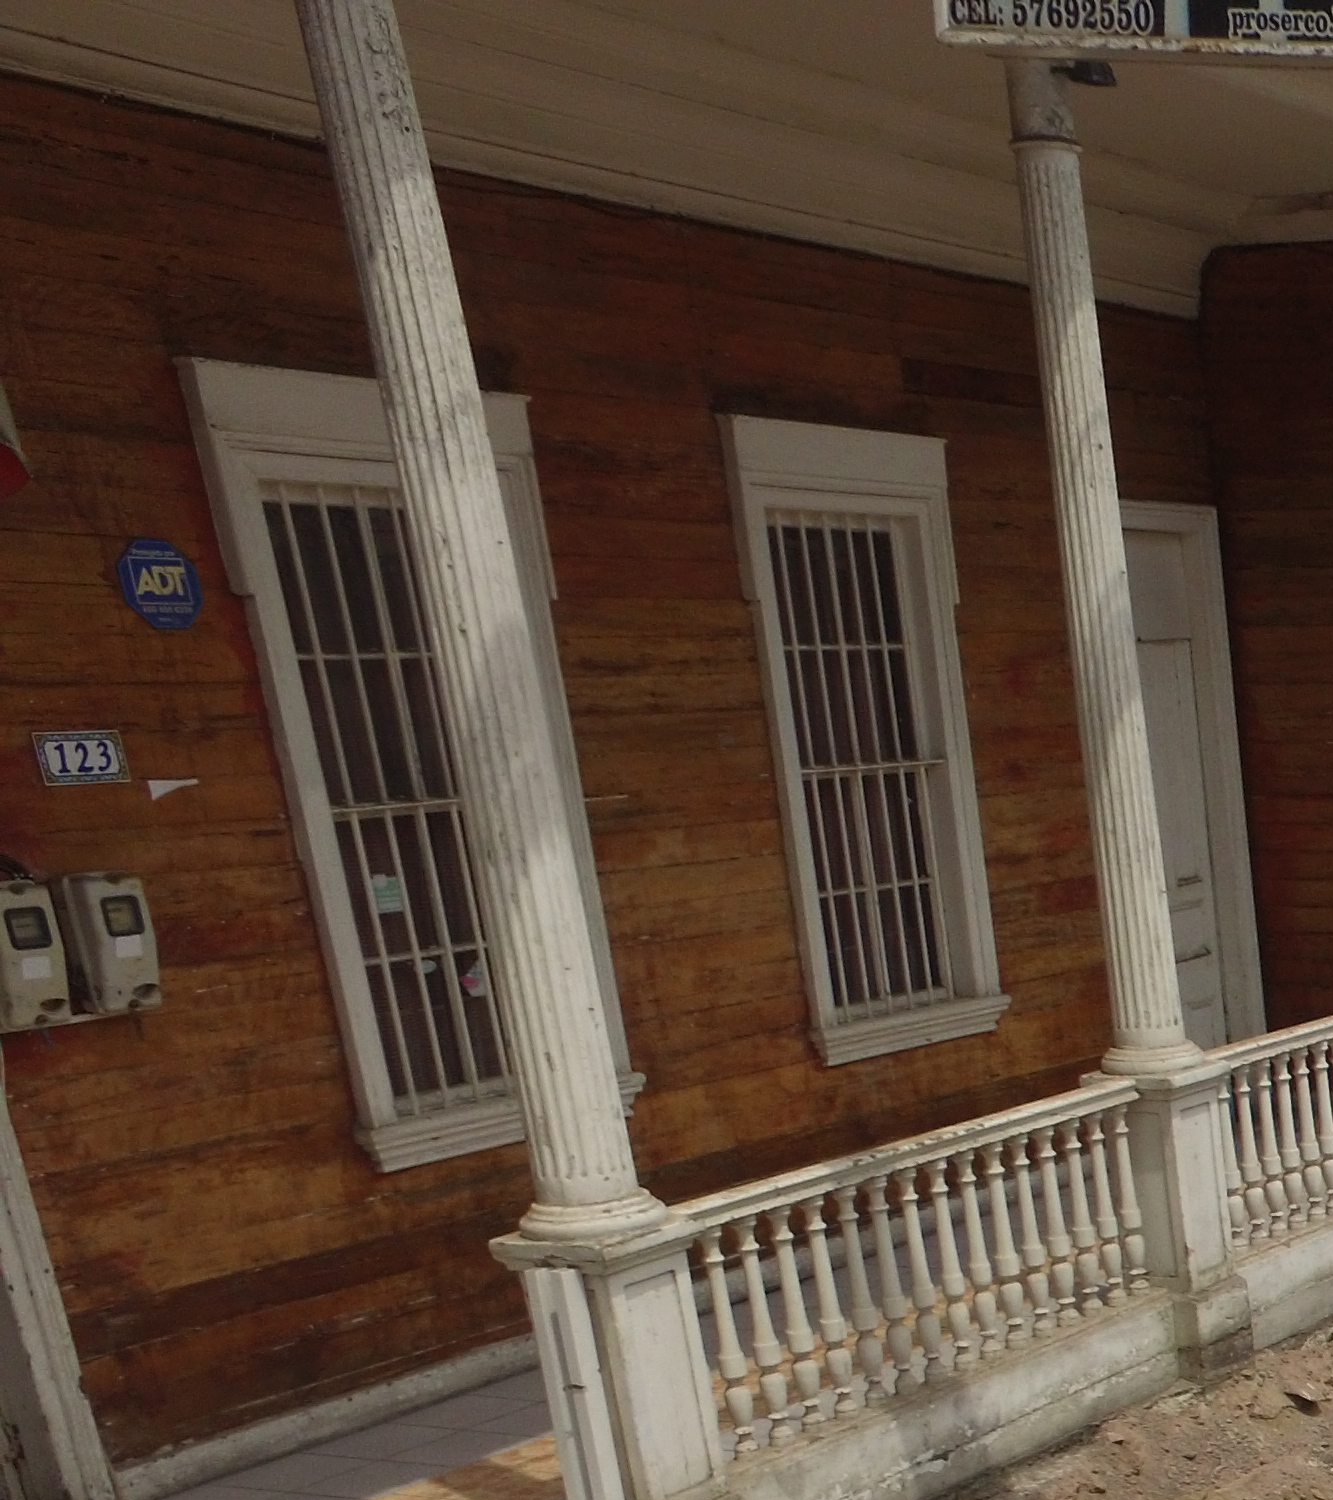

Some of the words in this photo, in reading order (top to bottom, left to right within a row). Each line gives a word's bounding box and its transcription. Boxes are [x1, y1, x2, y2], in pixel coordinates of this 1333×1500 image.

[1012, 0, 1151, 33] 57692550
[137, 565, 185, 596] ADT
[54, 742, 113, 773] 123
